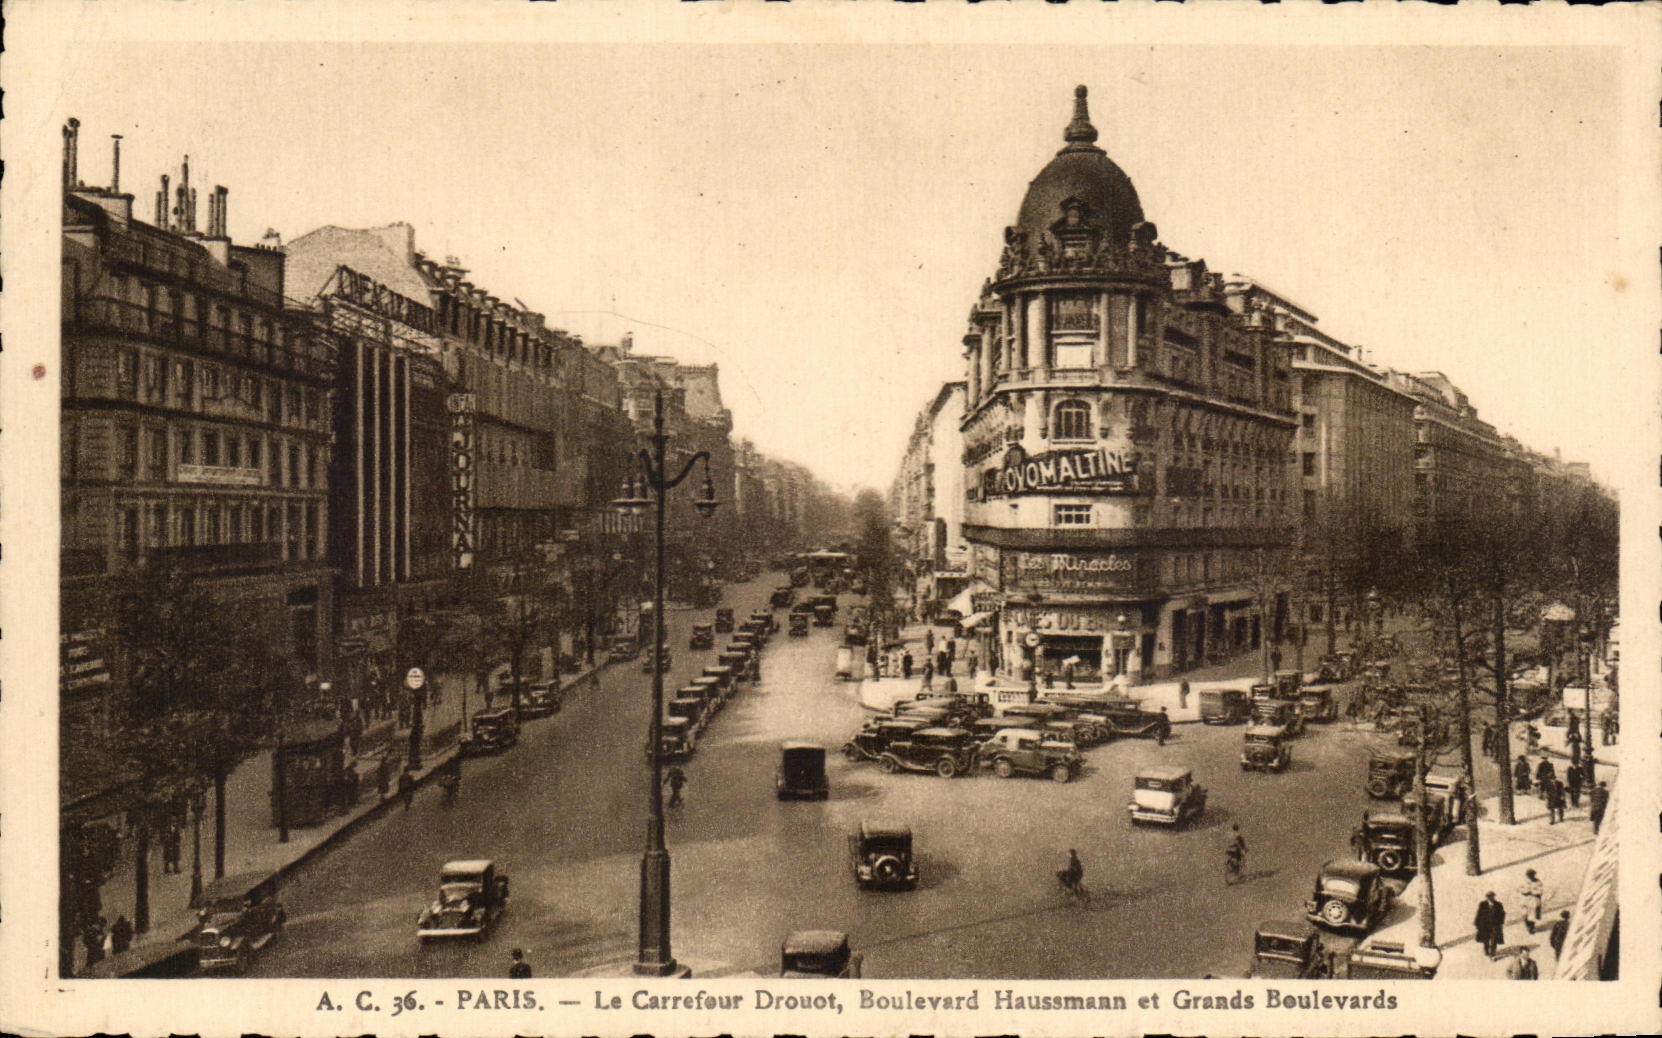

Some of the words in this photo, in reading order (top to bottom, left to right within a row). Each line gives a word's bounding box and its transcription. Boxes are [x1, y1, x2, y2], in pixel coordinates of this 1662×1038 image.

[1005, 450, 1133, 492] OVOMALTINE
[451, 430, 474, 571] JOURNAL
[1019, 552, 1045, 570] Les
[1050, 553, 1133, 575] Miracles
